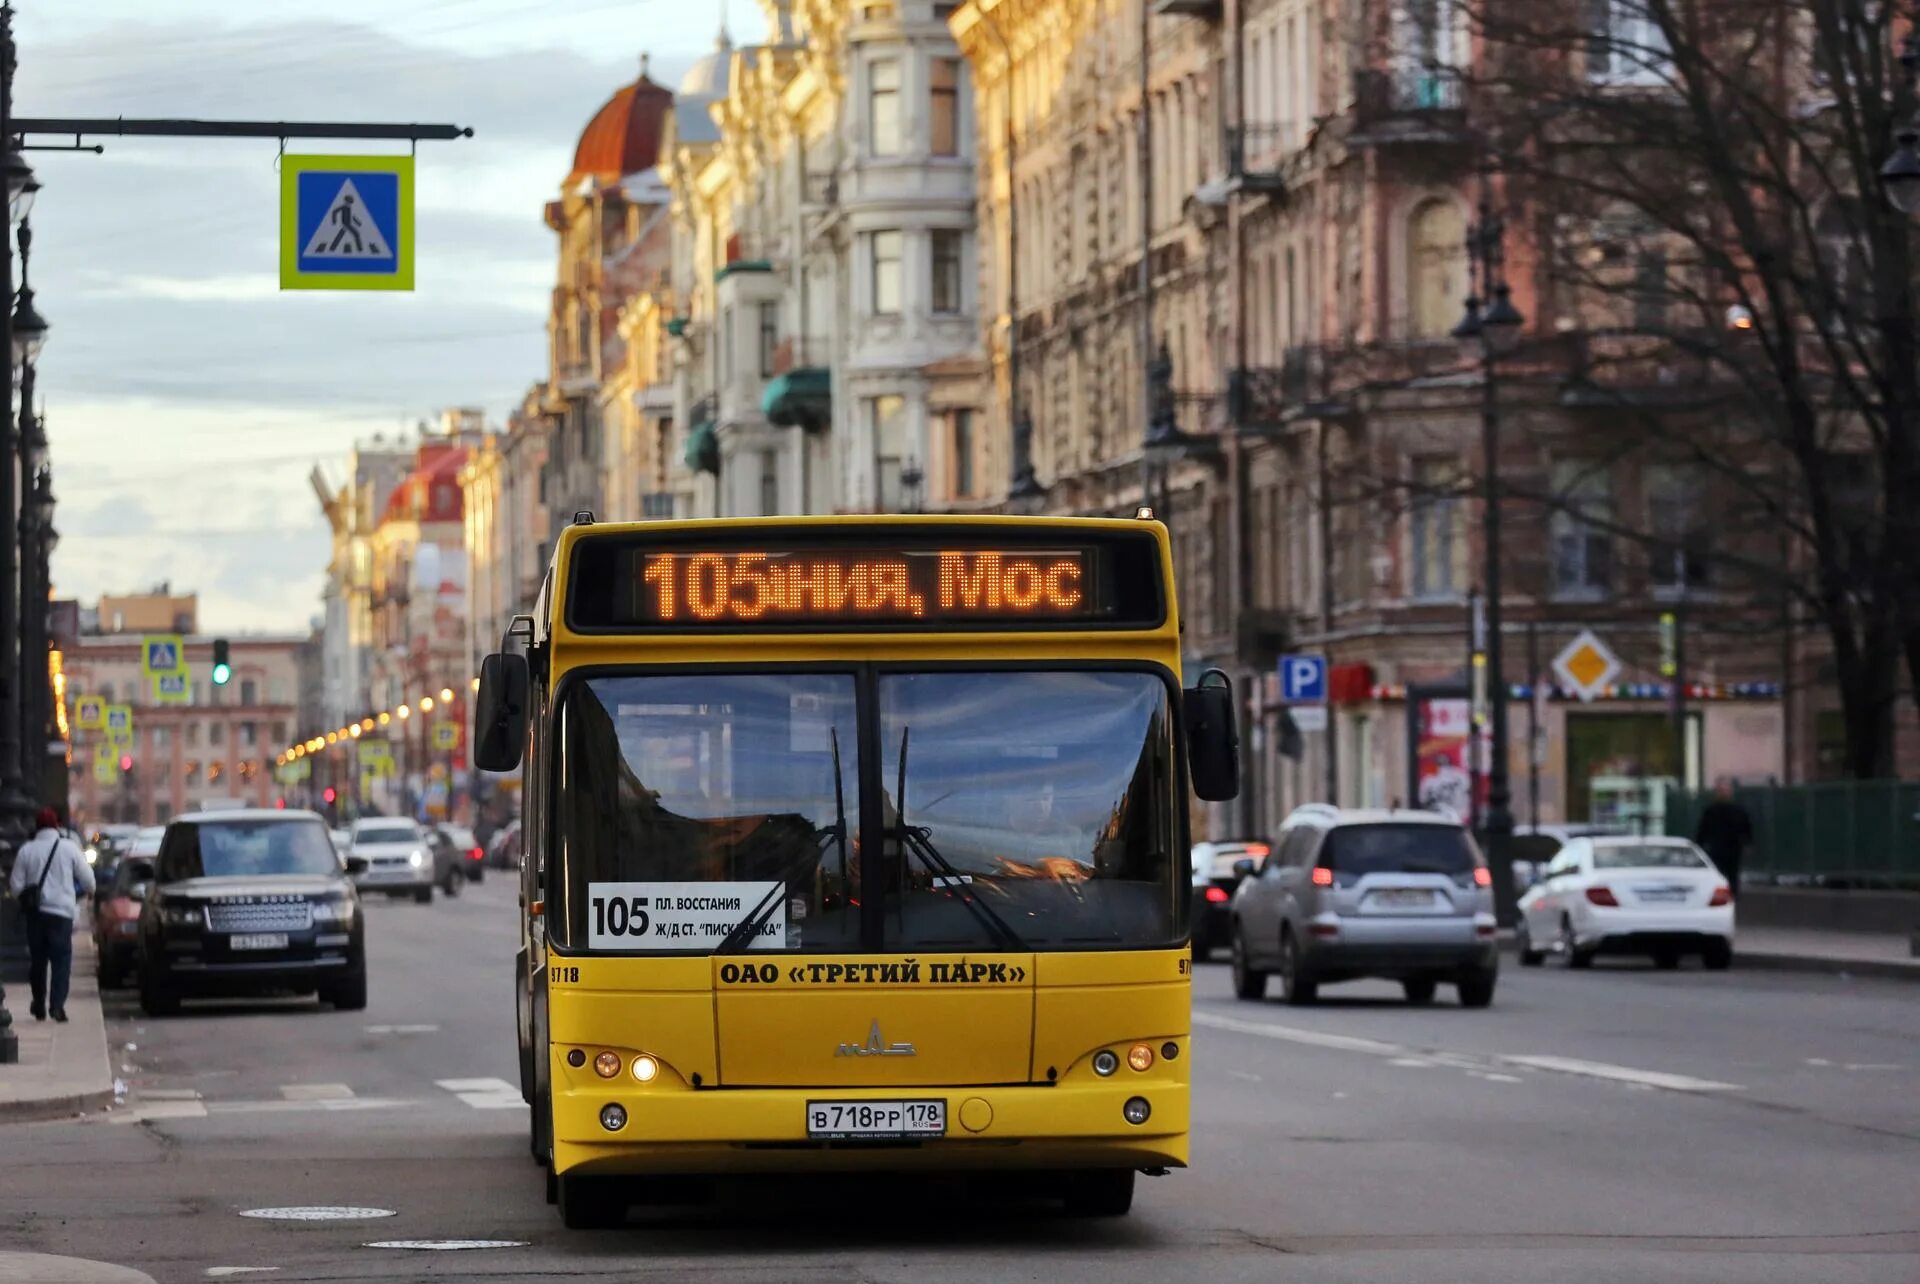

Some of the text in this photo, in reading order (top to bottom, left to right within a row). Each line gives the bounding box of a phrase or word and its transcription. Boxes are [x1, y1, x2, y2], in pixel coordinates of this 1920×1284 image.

[940, 552, 1081, 608] Мос
[655, 898, 741, 911] ПЛ. ВОССТАНИЯ
[593, 897, 649, 936] 105
[655, 923, 680, 938] Ж/Д
[682, 923, 697, 937] СТ.
[720, 958, 1026, 984] ОАО «ТРЕТИЙ ПАРК»
[906, 1104, 937, 1121] 178
[912, 1121, 929, 1129] RUS
